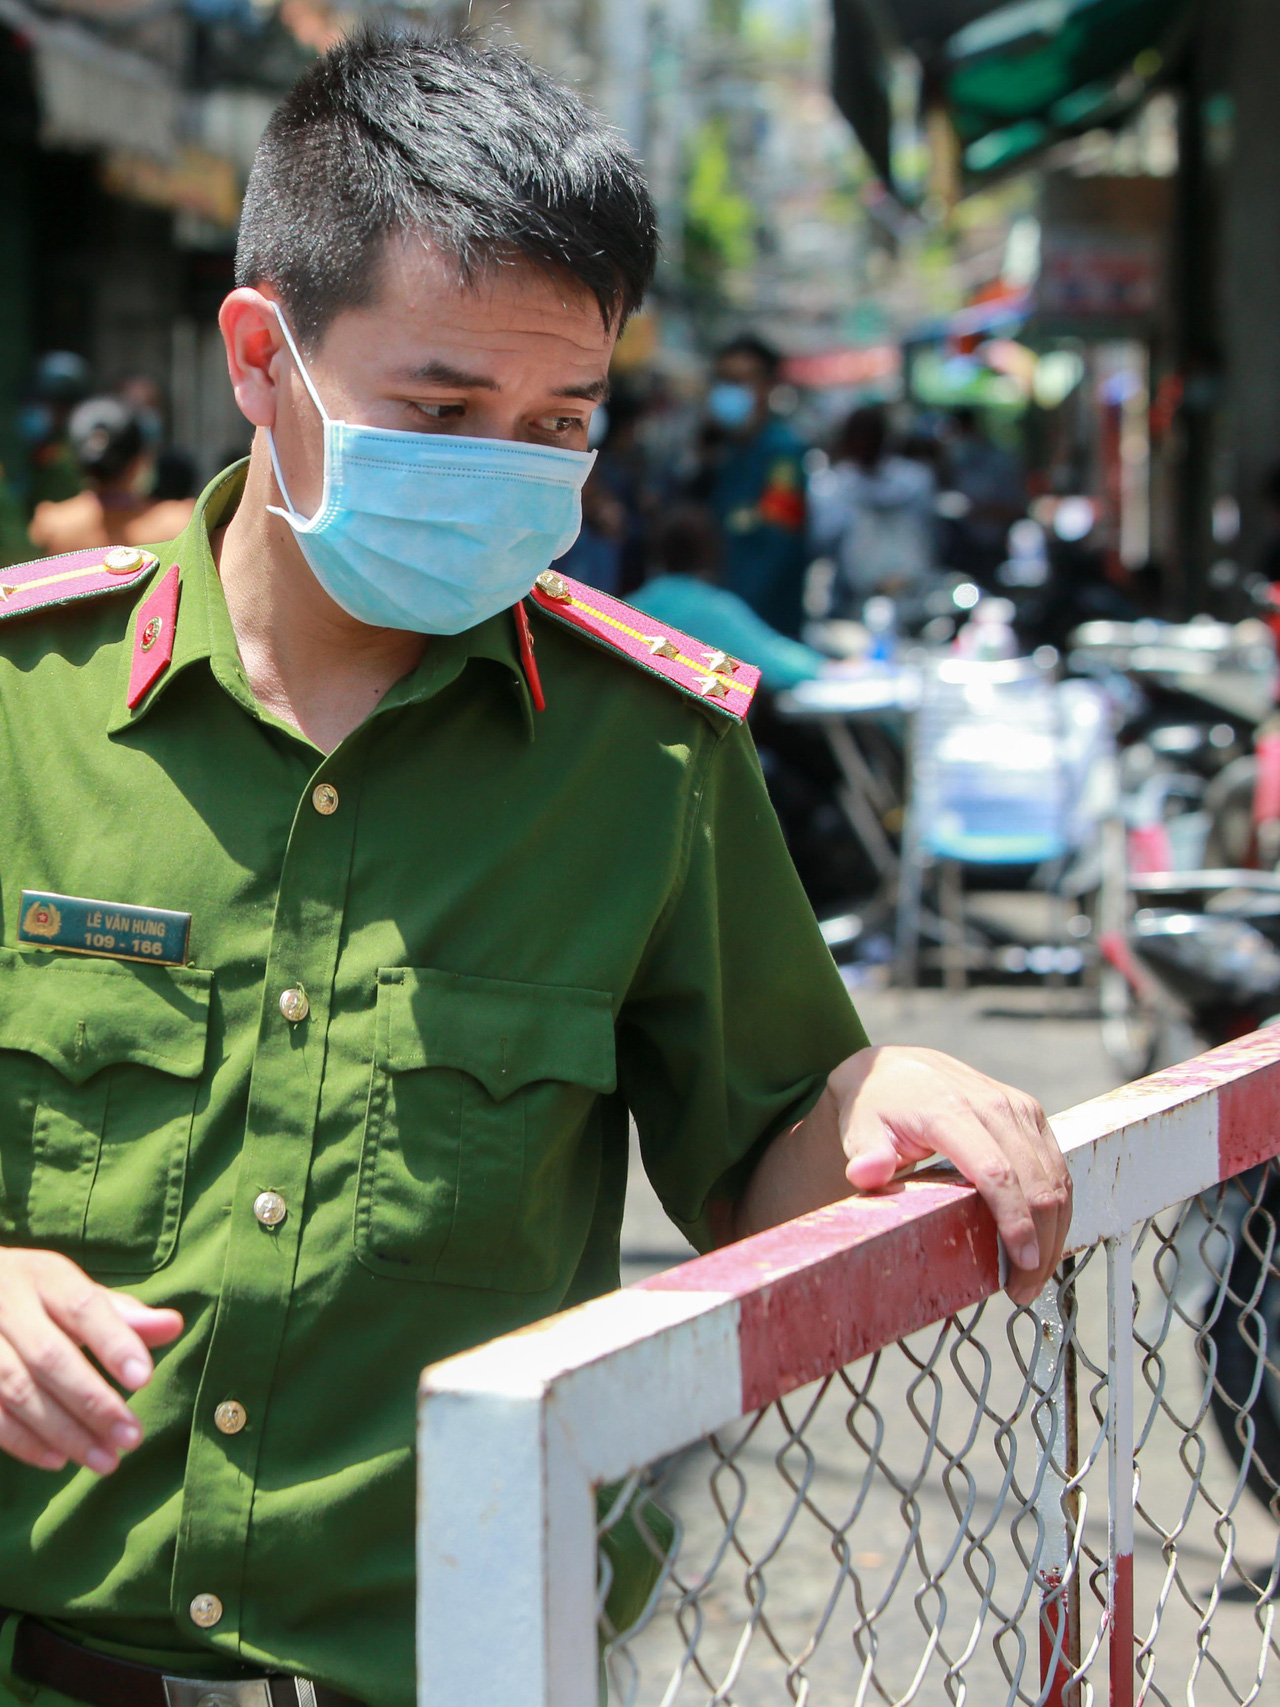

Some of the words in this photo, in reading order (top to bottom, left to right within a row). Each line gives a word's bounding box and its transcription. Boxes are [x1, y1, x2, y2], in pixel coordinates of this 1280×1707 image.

[87, 911, 101, 928] LÊ
[105, 914, 130, 932] VĂN
[84, 932, 115, 949] 109
[132, 939, 163, 956] 166
